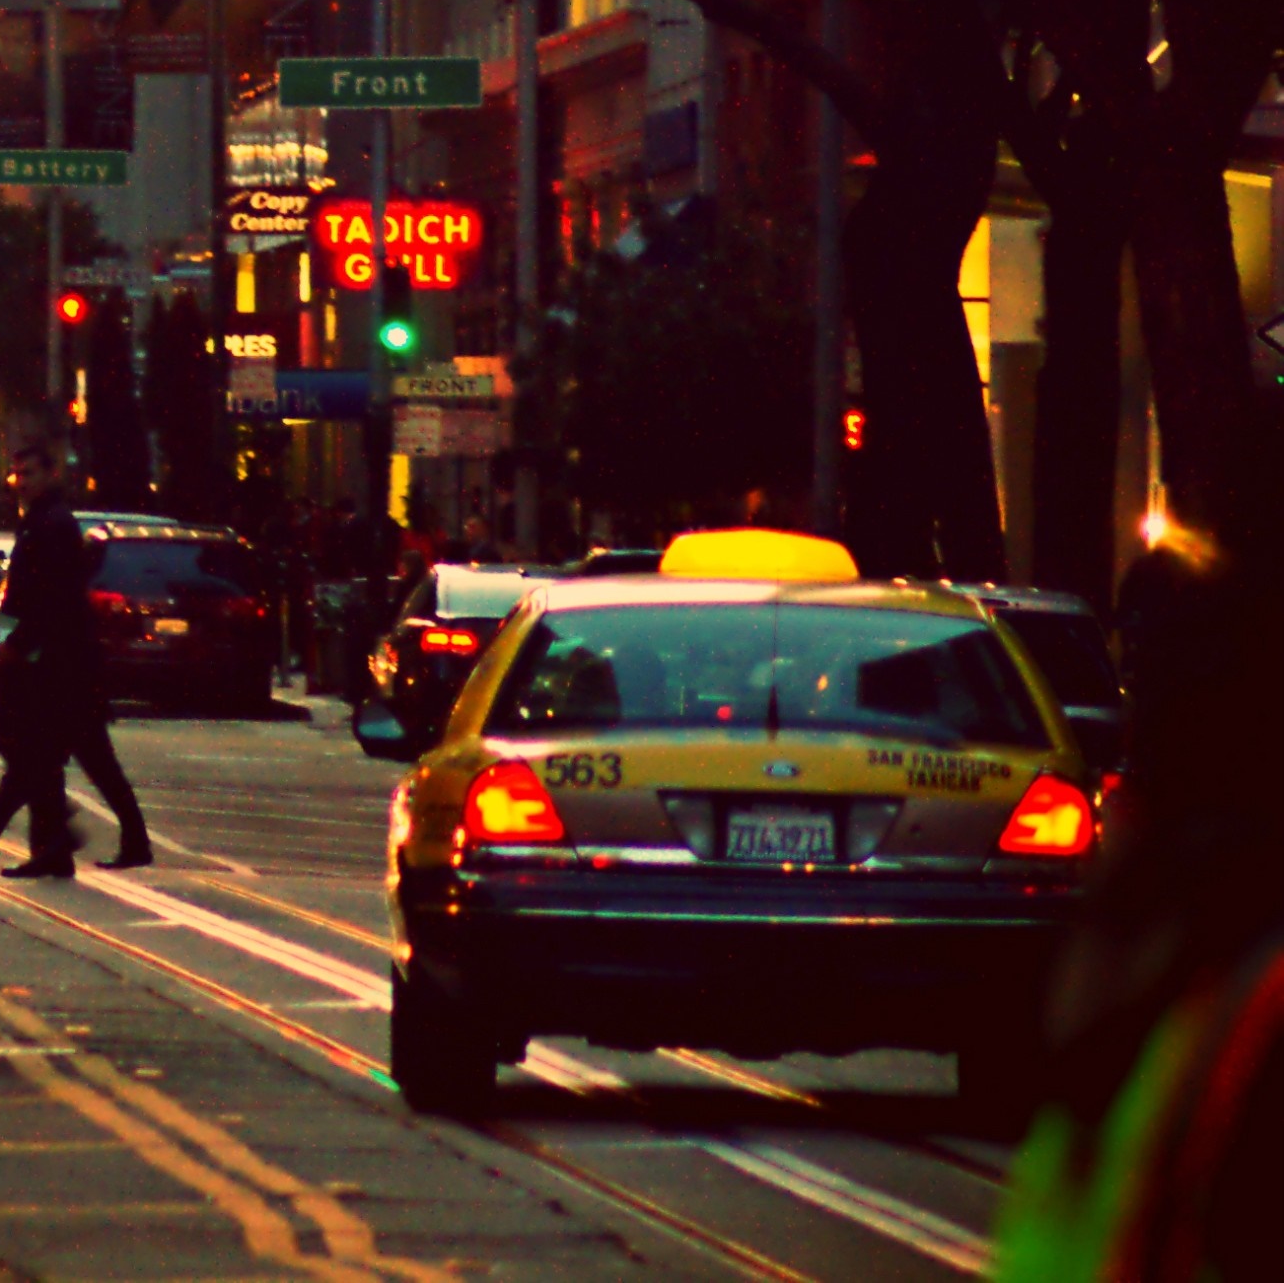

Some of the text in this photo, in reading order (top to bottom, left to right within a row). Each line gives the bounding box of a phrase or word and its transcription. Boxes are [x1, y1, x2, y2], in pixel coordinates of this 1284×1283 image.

[332, 70, 428, 96] Front
[2, 157, 109, 181] Battery
[249, 190, 309, 214] Copy
[229, 212, 309, 232] Center
[343, 252, 453, 283] GLL
[408, 379, 479, 395] FRONT
[544, 752, 623, 788] 563
[867, 749, 1012, 779] SAN FRANCISCO
[907, 769, 981, 793] TAXICAB
